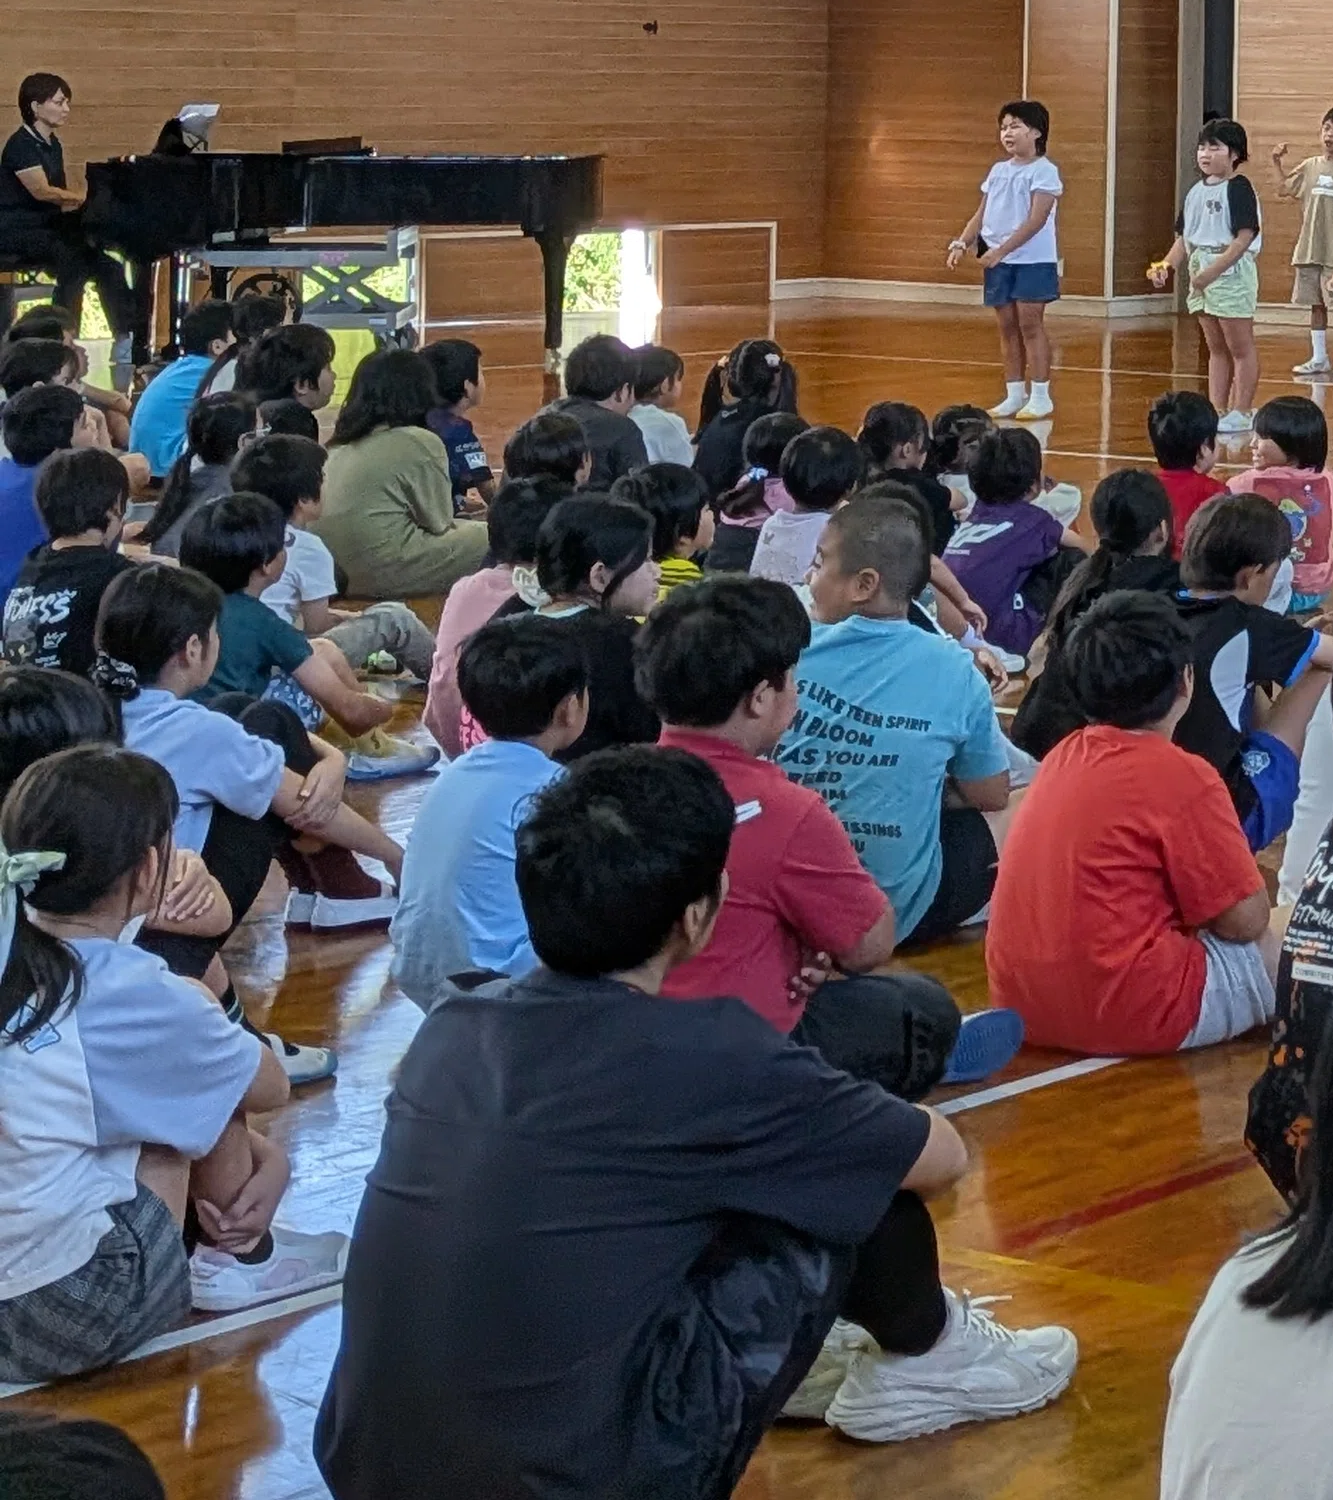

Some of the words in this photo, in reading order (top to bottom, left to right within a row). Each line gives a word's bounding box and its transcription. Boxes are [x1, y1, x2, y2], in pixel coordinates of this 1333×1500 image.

[808, 682, 846, 714] LIKE
[847, 704, 883, 728] TEEN
[886, 715, 931, 732] SPIRIT
[805, 716, 875, 747] BLOOM
[825, 750, 865, 766] YOU
[867, 753, 899, 767] ARE
